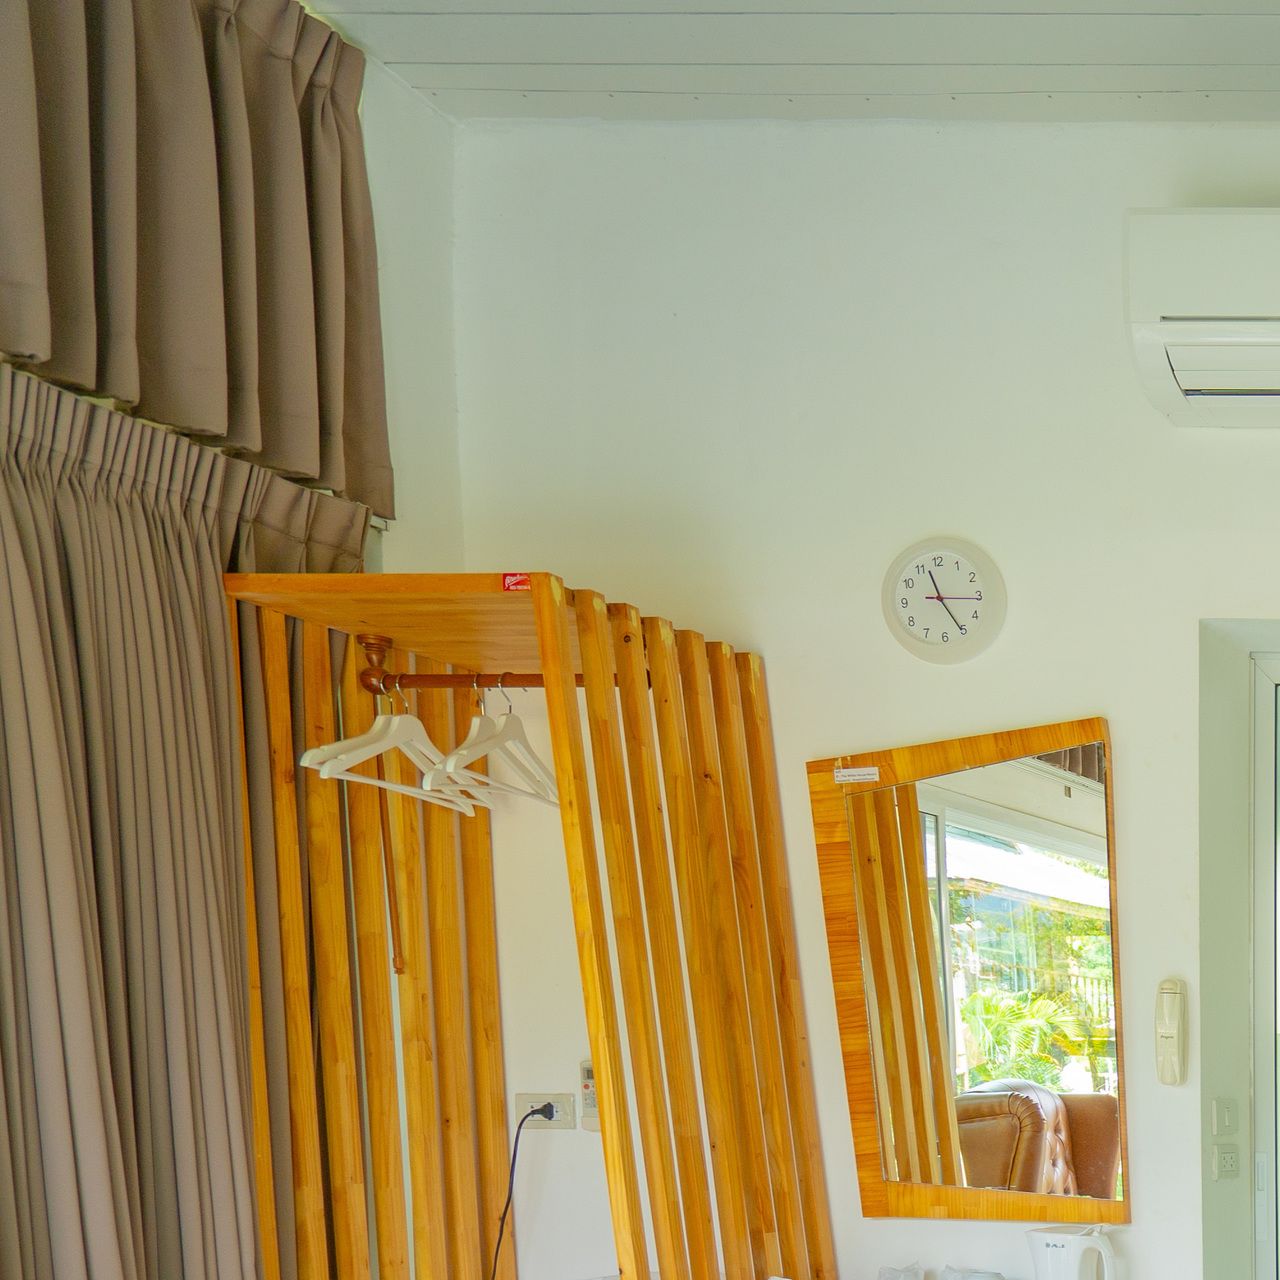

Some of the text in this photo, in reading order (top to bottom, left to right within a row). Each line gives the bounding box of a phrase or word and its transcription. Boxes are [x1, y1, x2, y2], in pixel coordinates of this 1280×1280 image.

[932, 556, 944, 567] 12
[954, 560, 960, 571] 1
[915, 564, 925, 575] 11
[968, 572, 976, 583] 2
[903, 578, 914, 589] 10
[975, 590, 983, 601] 3
[900, 597, 908, 608] 9
[971, 610, 979, 620] 4
[908, 616, 915, 627] 8
[923, 628, 930, 639] 7
[960, 624, 967, 635] 5
[941, 631, 949, 643] 6
